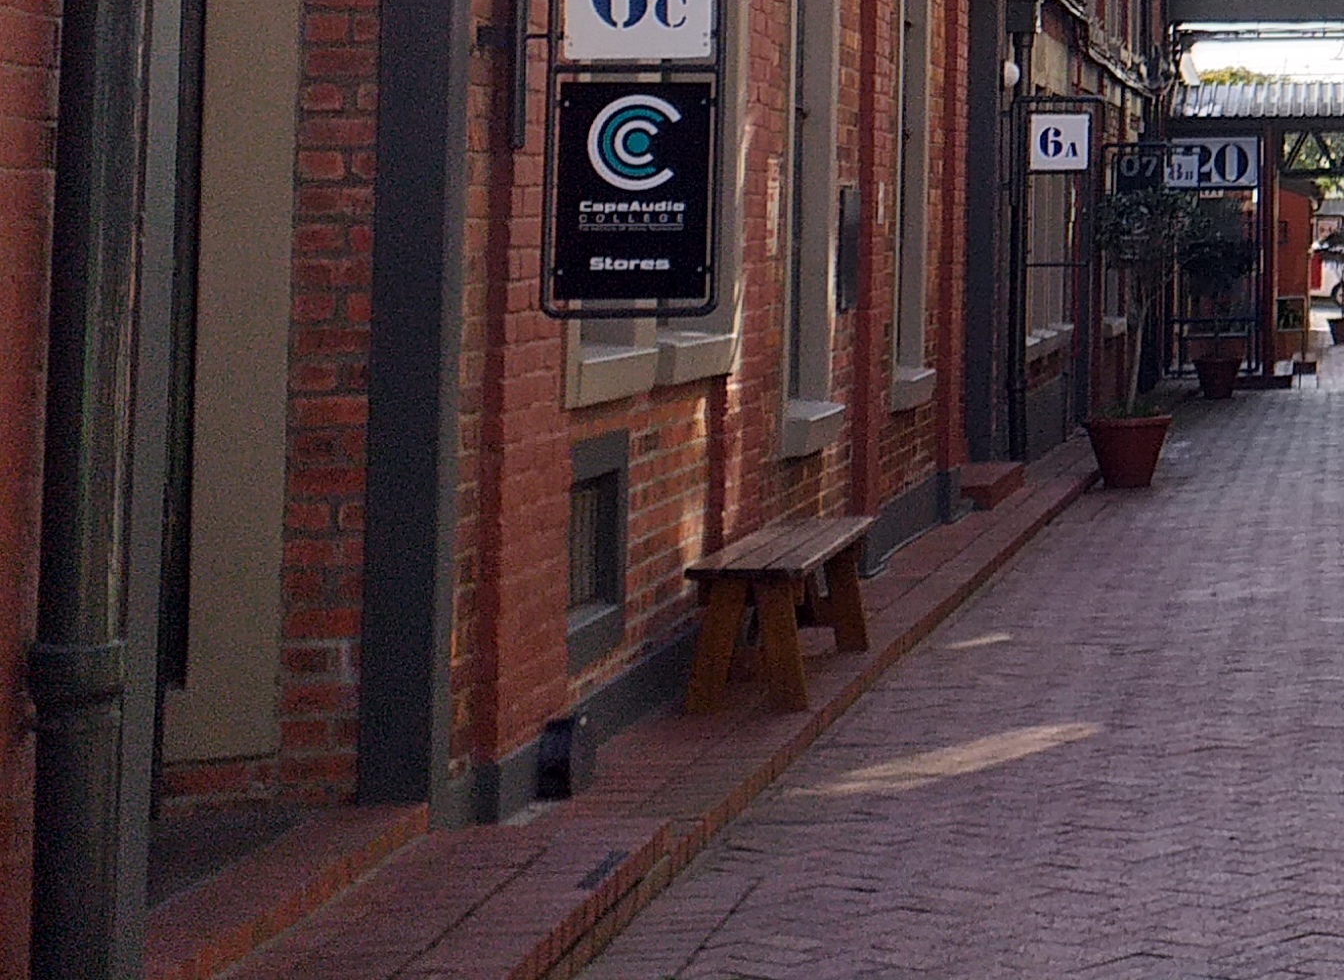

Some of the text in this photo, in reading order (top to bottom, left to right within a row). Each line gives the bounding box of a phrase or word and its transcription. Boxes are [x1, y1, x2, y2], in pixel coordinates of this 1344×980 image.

[1039, 127, 1078, 158] 6A
[580, 201, 685, 213] CapeAudio
[579, 214, 684, 223] COLLEGE
[590, 256, 670, 270] Stores
